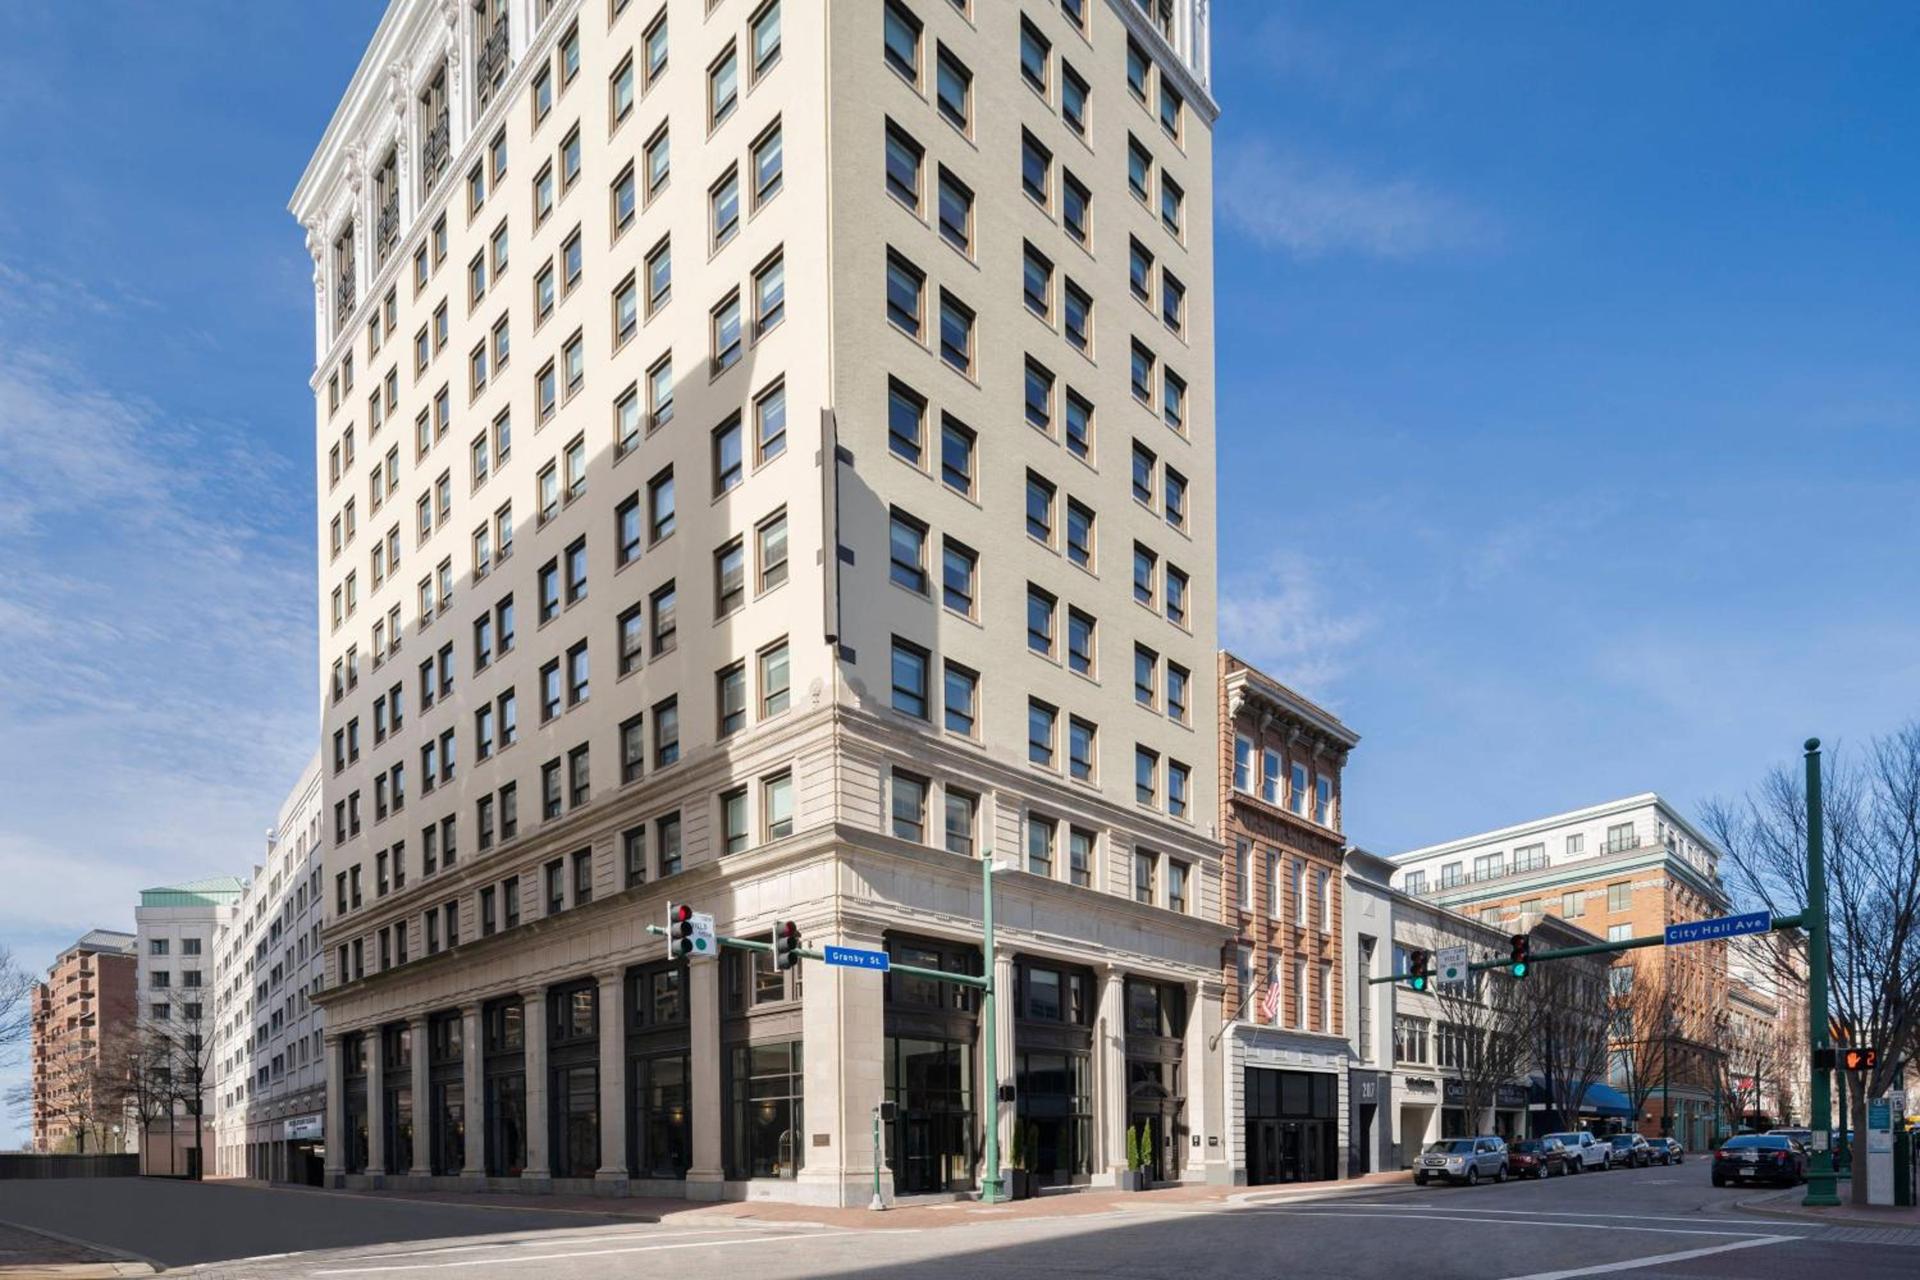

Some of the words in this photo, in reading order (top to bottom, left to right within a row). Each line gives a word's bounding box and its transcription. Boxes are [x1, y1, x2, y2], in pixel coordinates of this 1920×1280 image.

[1669, 929, 1697, 940] City
[1702, 923, 1730, 935] Hall
[1735, 919, 1765, 931] Ave.
[833, 952, 864, 965] Granby
